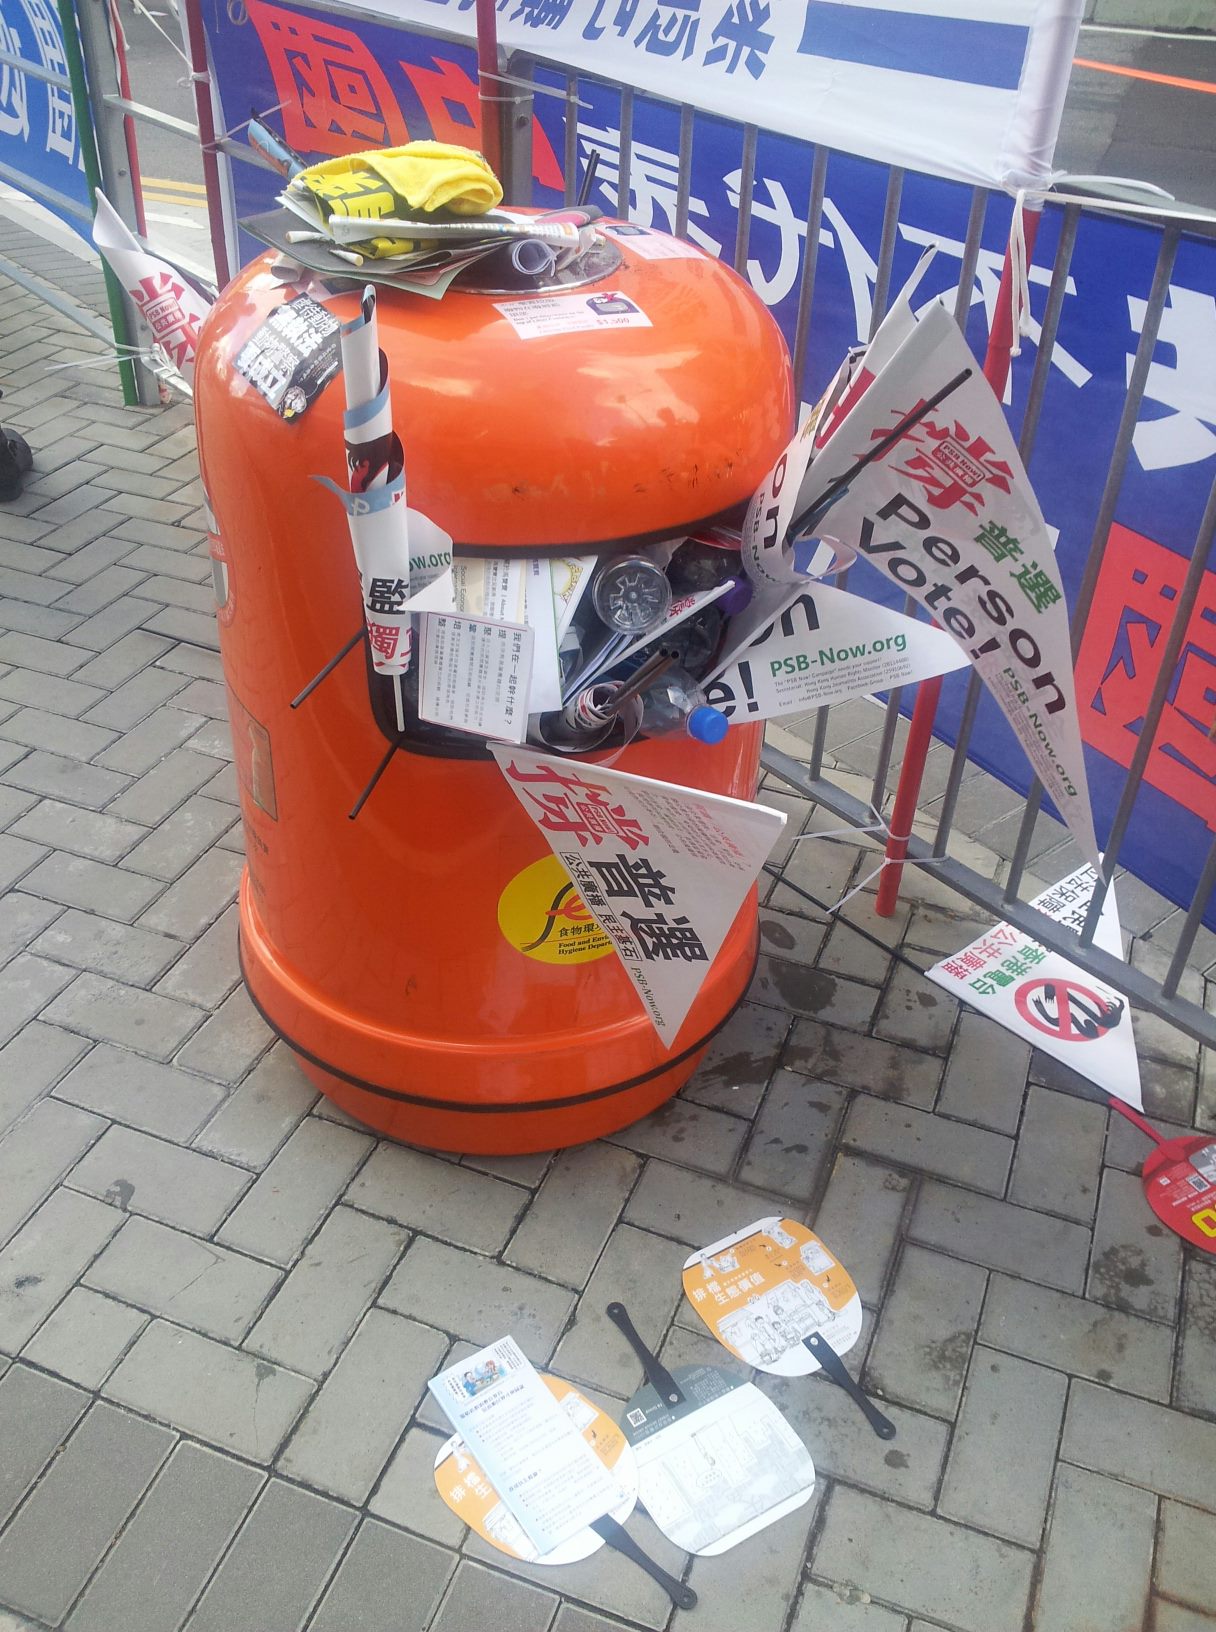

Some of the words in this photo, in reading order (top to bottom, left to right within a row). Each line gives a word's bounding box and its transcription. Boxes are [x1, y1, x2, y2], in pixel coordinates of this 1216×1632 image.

[859, 516, 1002, 660] Vote!
[876, 493, 1067, 716] Person
[974, 519, 1062, 615] 普選
[769, 633, 908, 678] PSB-Now.org
[1000, 667, 1079, 799] PSB-Now.org
[558, 941, 576, 949] Food
[577, 938, 591, 946] and
[558, 946, 587, 956] Hygiene
[564, 853, 606, 909] 公共廣播
[598, 912, 640, 961] 民主基石
[589, 853, 711, 962] 普選
[631, 966, 666, 1028] PSB-Now.org
[969, 942, 1048, 997] 香港電台
